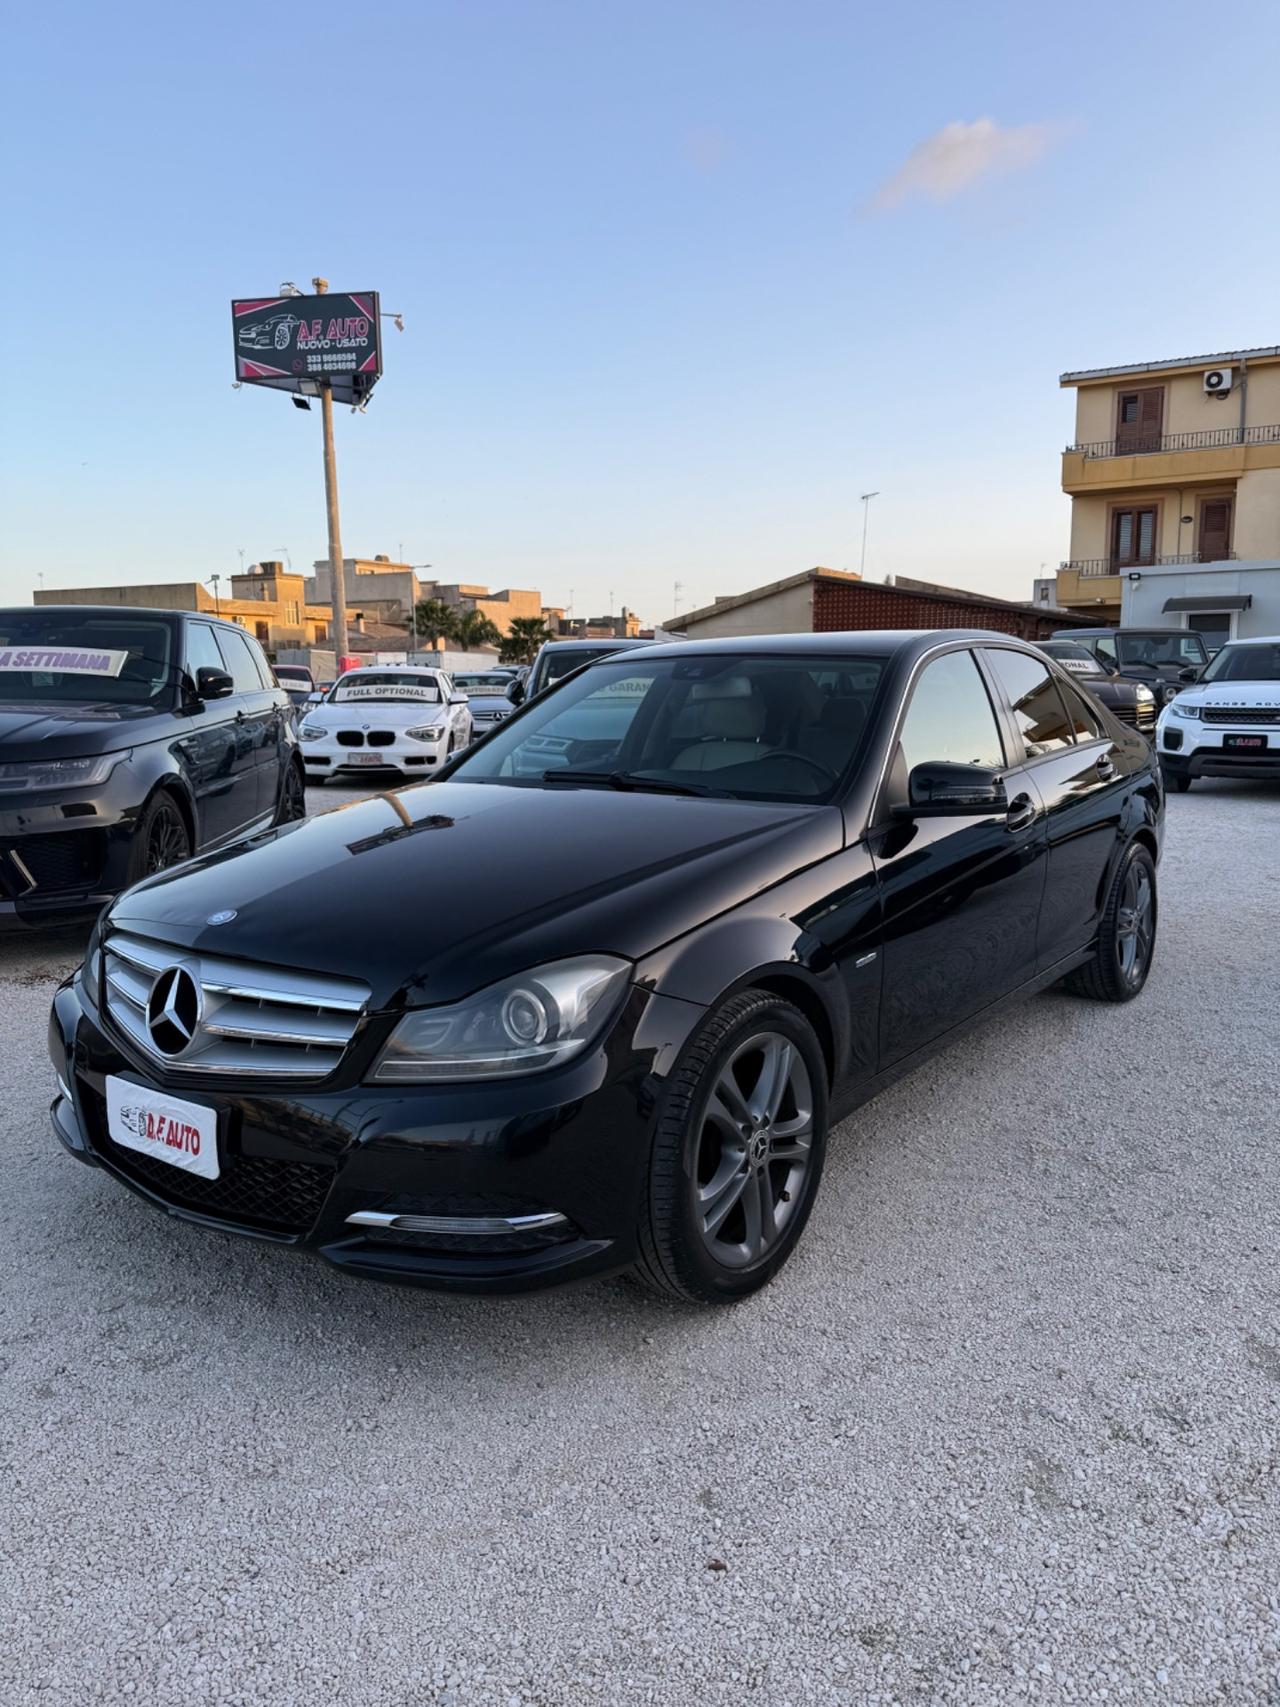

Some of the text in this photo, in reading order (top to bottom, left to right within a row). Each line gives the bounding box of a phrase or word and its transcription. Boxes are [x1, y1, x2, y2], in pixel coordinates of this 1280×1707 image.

[326, 317, 369, 339] AUTO
[297, 340, 330, 349] NUOVO
[336, 338, 368, 348] USATO
[12, 651, 111, 671] SETTIMANA
[347, 687, 427, 697] FULL OPTIONAL
[166, 1119, 201, 1156] AUTO
